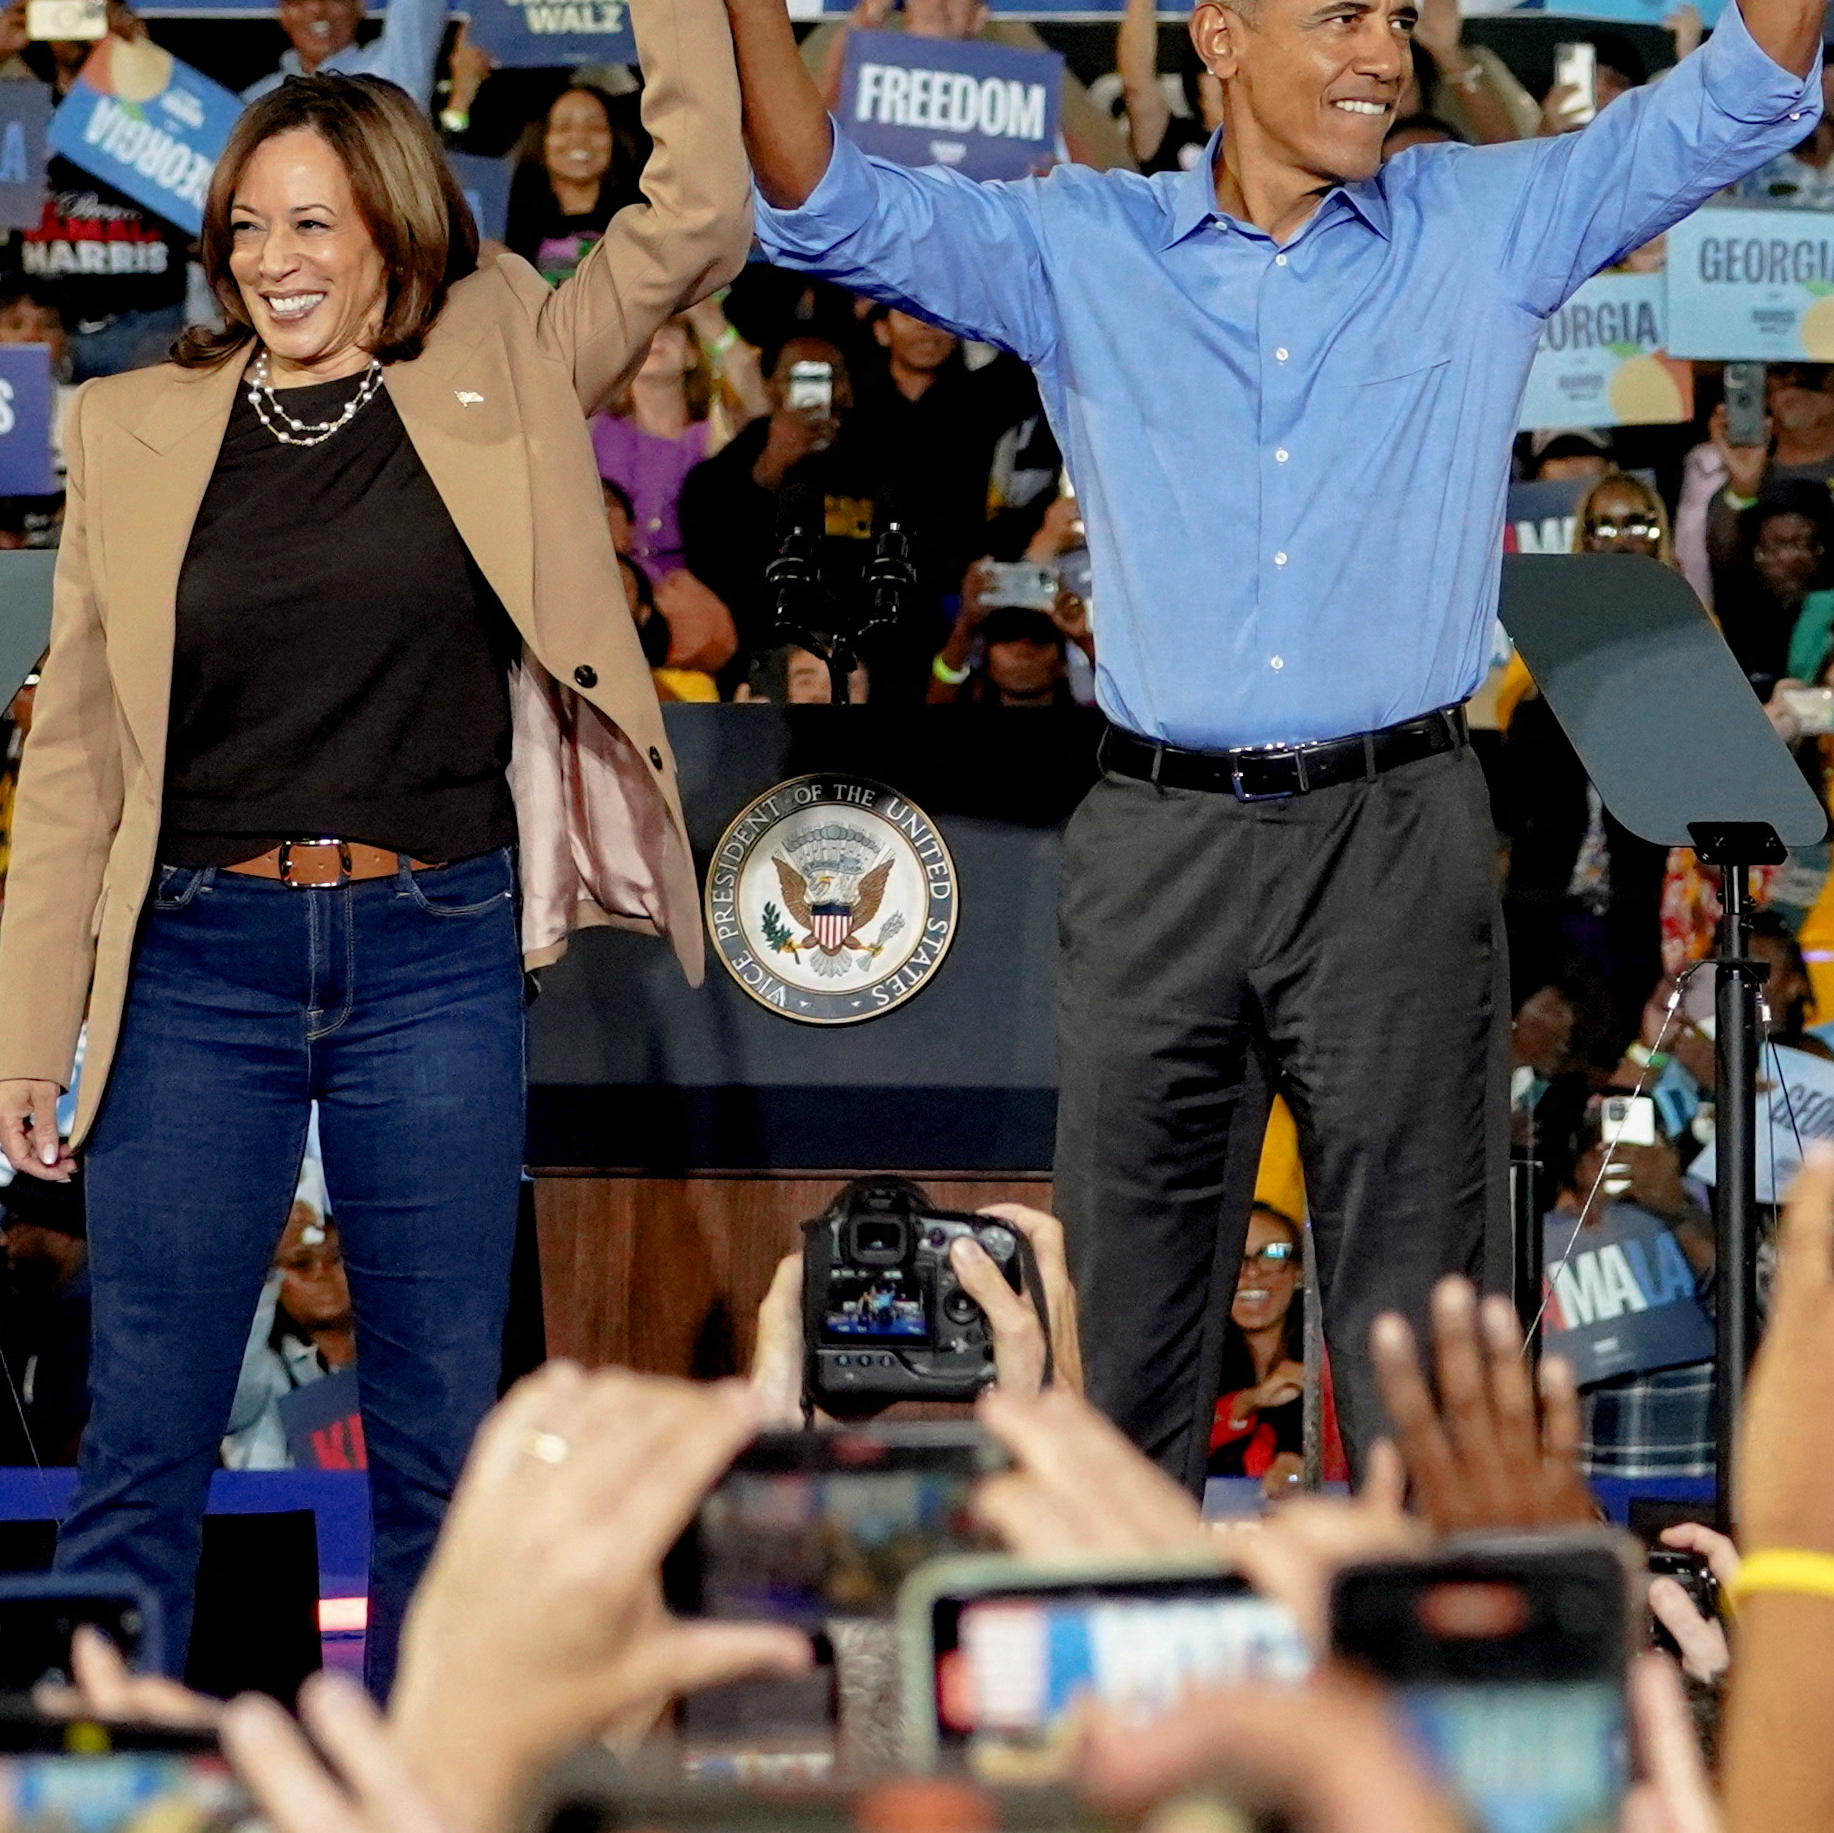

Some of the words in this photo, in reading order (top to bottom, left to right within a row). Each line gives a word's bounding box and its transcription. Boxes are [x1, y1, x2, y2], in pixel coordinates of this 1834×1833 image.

[525, 4, 624, 35] WALZ
[855, 62, 1047, 142] FREEDOM
[21, 239, 169, 276] HARRIS
[794, 784, 823, 805] OF
[833, 783, 876, 807] THE
[713, 795, 782, 941] PRESIDENT
[885, 796, 952, 901] UNITED
[732, 949, 788, 1008] VICE
[871, 917, 949, 1007] STATES
